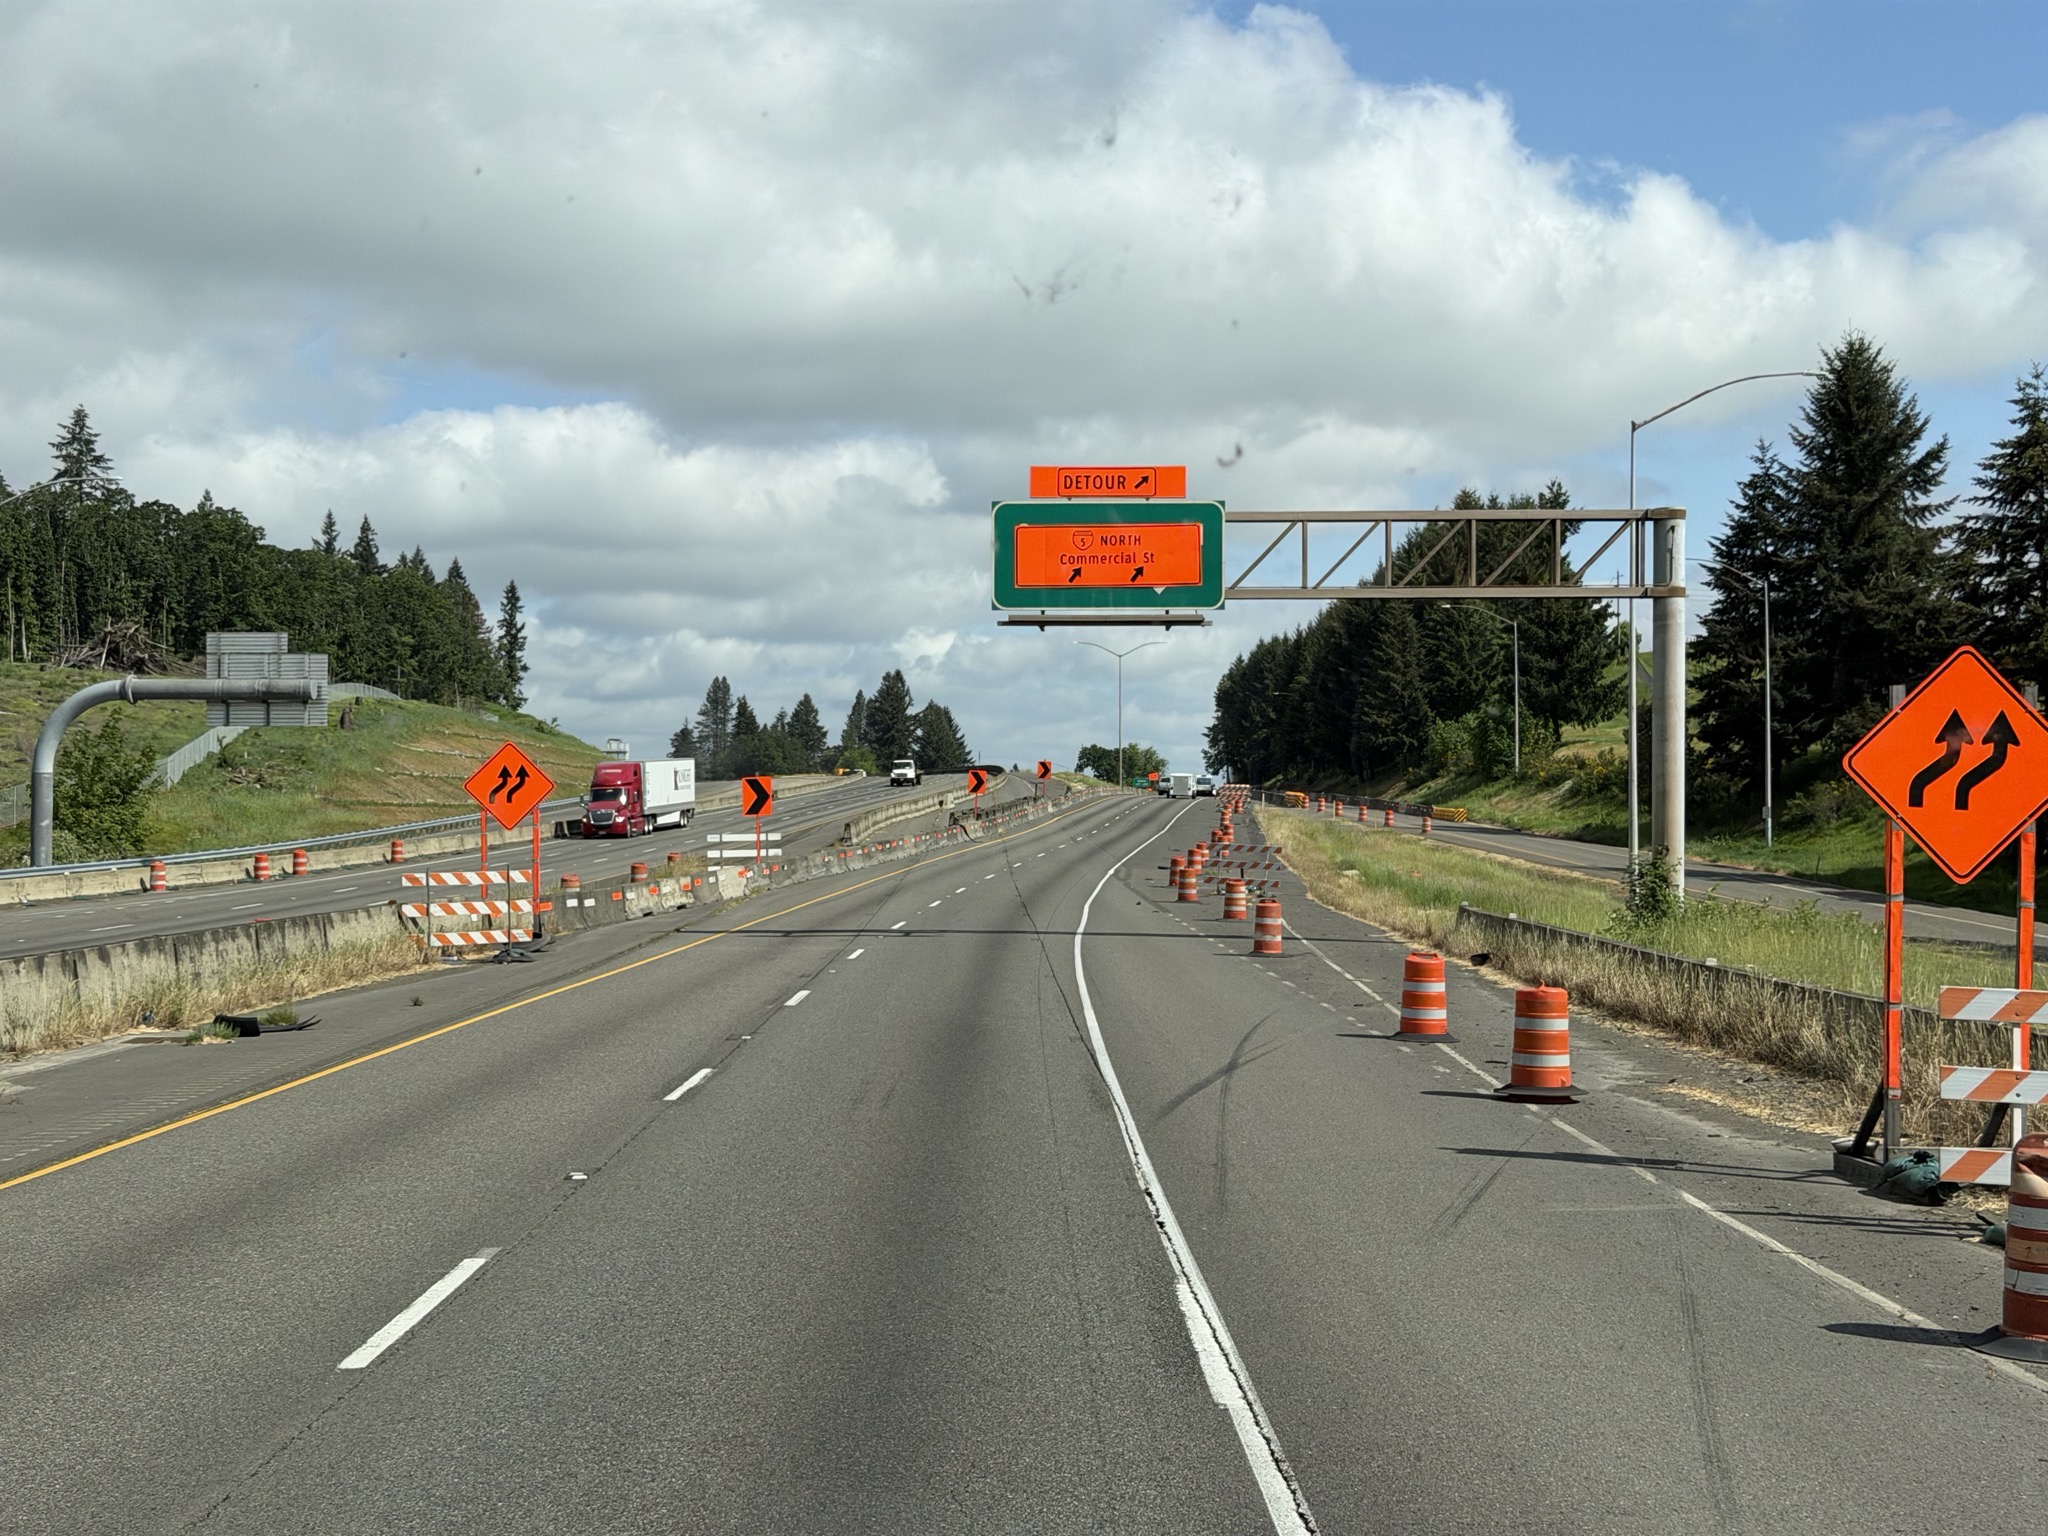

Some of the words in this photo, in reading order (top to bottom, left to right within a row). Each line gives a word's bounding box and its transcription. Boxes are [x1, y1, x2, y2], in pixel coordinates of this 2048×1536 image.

[1063, 475, 1126, 490] DETOUR
[1080, 537, 1086, 547] 5
[1100, 535, 1141, 546] NORTH
[1060, 552, 1137, 565] Commercial
[1143, 552, 1155, 563] St
